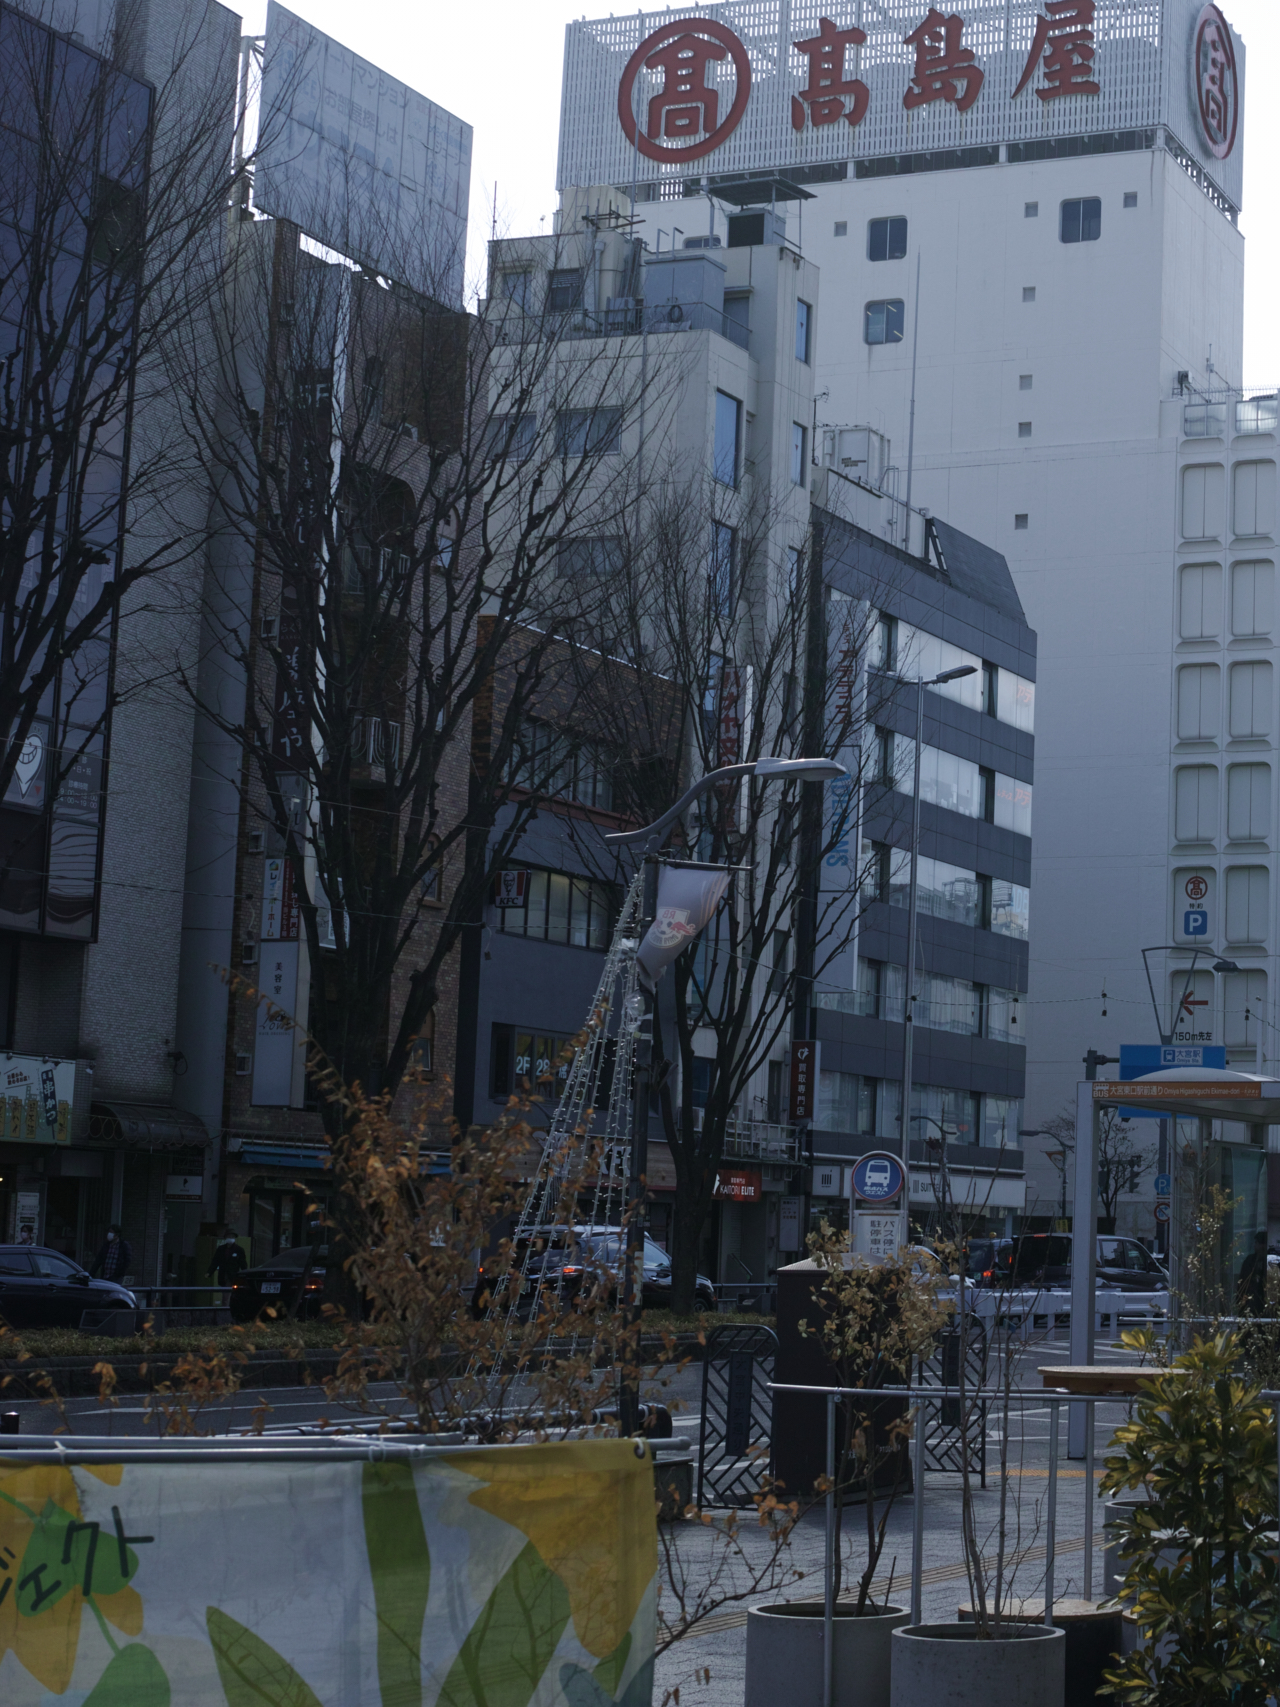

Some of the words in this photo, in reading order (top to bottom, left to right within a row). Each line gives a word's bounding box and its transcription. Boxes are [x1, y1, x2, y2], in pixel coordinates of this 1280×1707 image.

[498, 896, 519, 905] KFC
[274, 962, 283, 994] 美容室
[1174, 1031, 1212, 1041] 150m先左
[1176, 1050, 1201, 1059] 大宮駅
[796, 1063, 807, 1116] 買取専門店
[1093, 1090, 1109, 1098] BUS
[1110, 1086, 1164, 1096] 大宮東口駅前通り
[1164, 1088, 1179, 1096] Omiya
[1180, 1087, 1210, 1096] Higashiguchi
[1211, 1087, 1240, 1095] Ekimae-dori
[44, 1080, 56, 1121] 串かつ
[741, 1185, 755, 1196] ELITE
[870, 1220, 881, 1254] 駐停車は
